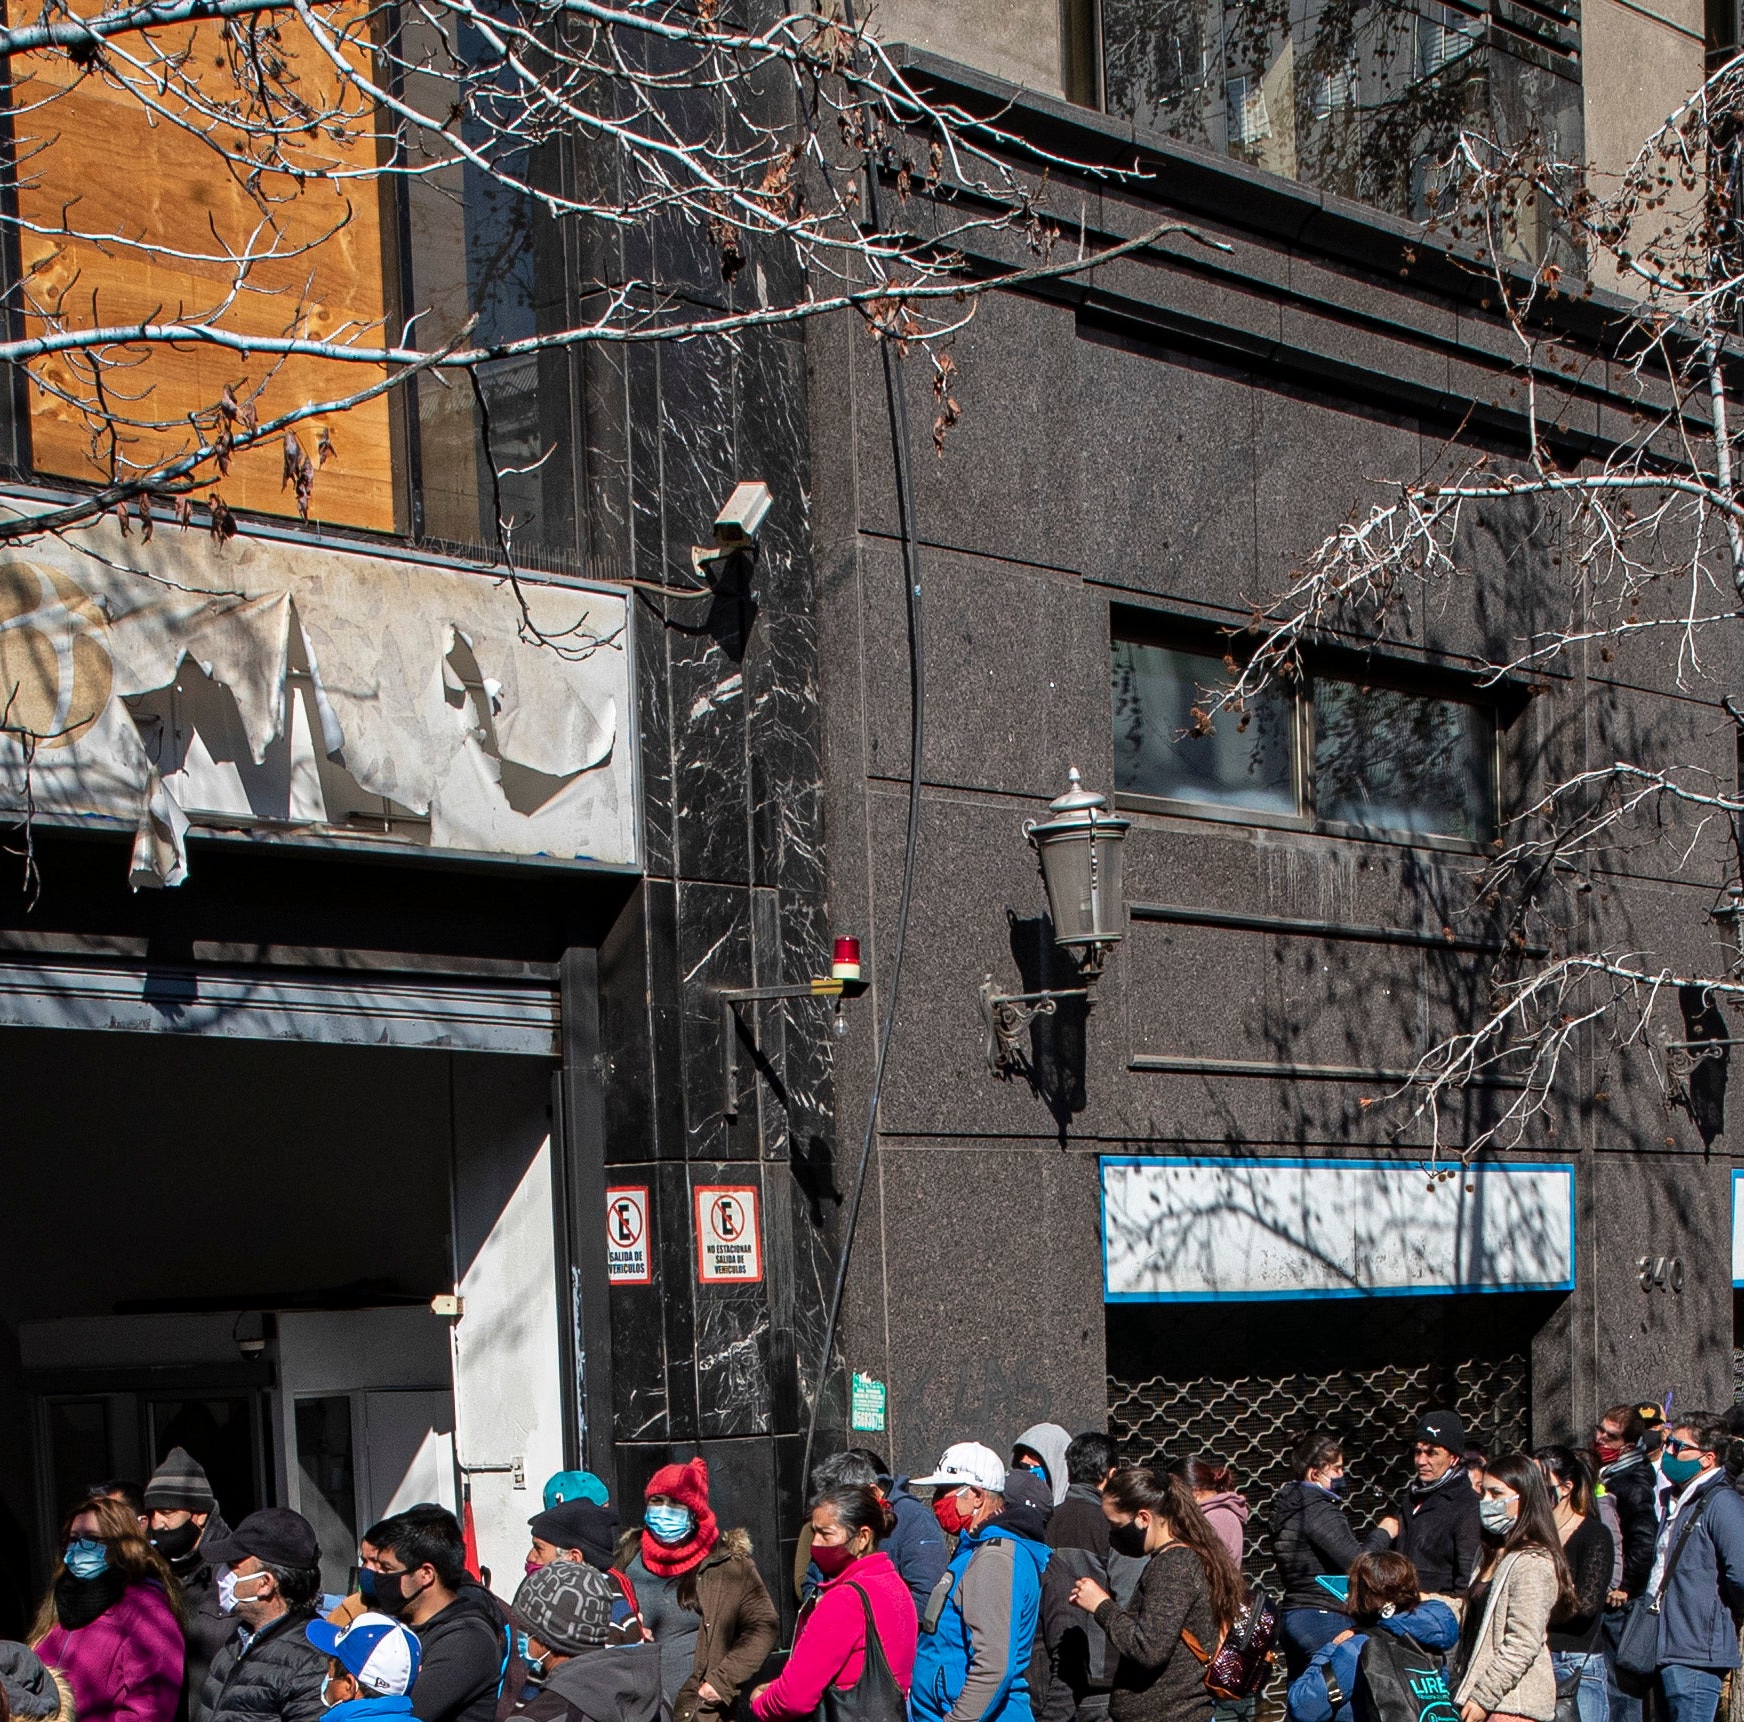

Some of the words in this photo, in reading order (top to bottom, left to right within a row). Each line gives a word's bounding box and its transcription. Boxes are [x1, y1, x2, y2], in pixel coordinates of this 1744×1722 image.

[707, 1244, 716, 1254] NO
[716, 1244, 752, 1254] ESTACIONAR
[610, 1251, 632, 1262] SALIDA
[634, 1251, 643, 1262] DE
[715, 1254, 735, 1264] SALIDA
[737, 1255, 744, 1264] DE
[1636, 1255, 1685, 1294] 840
